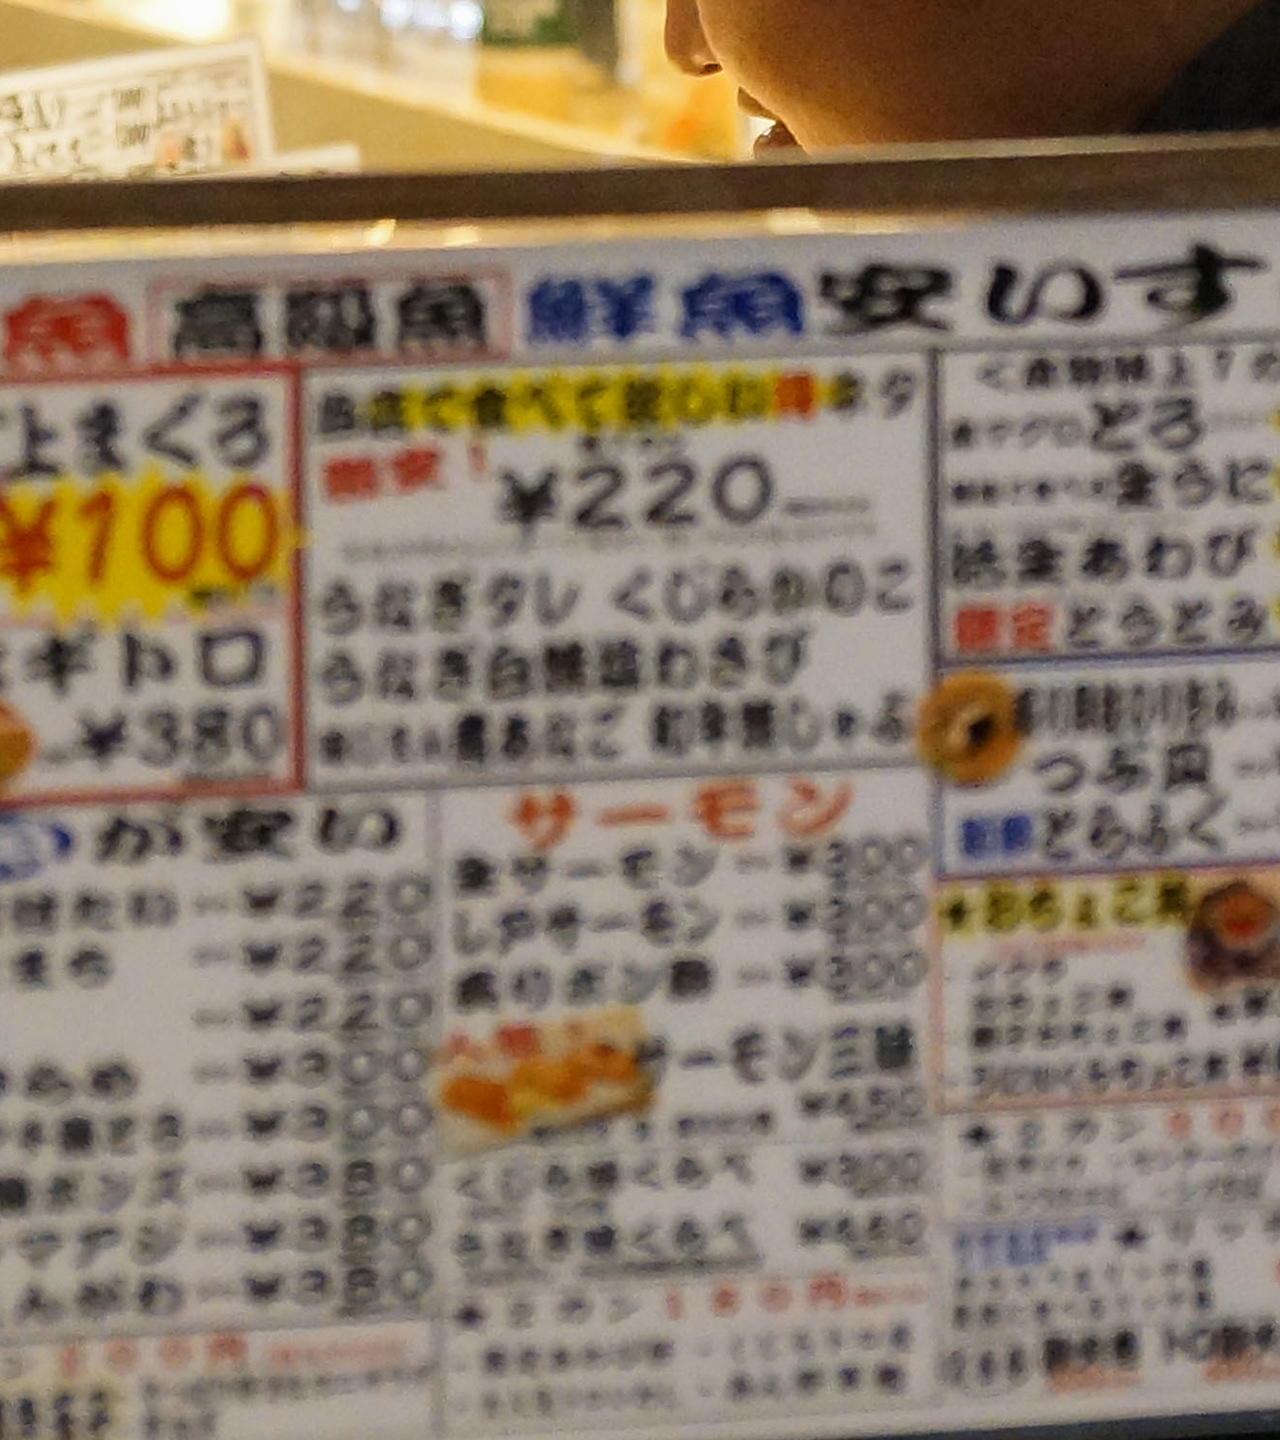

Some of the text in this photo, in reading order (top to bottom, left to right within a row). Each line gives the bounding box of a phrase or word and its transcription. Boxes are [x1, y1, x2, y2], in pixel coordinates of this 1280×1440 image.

[498, 454, 775, 538] ¥220
[510, 775, 854, 850] サーモン
